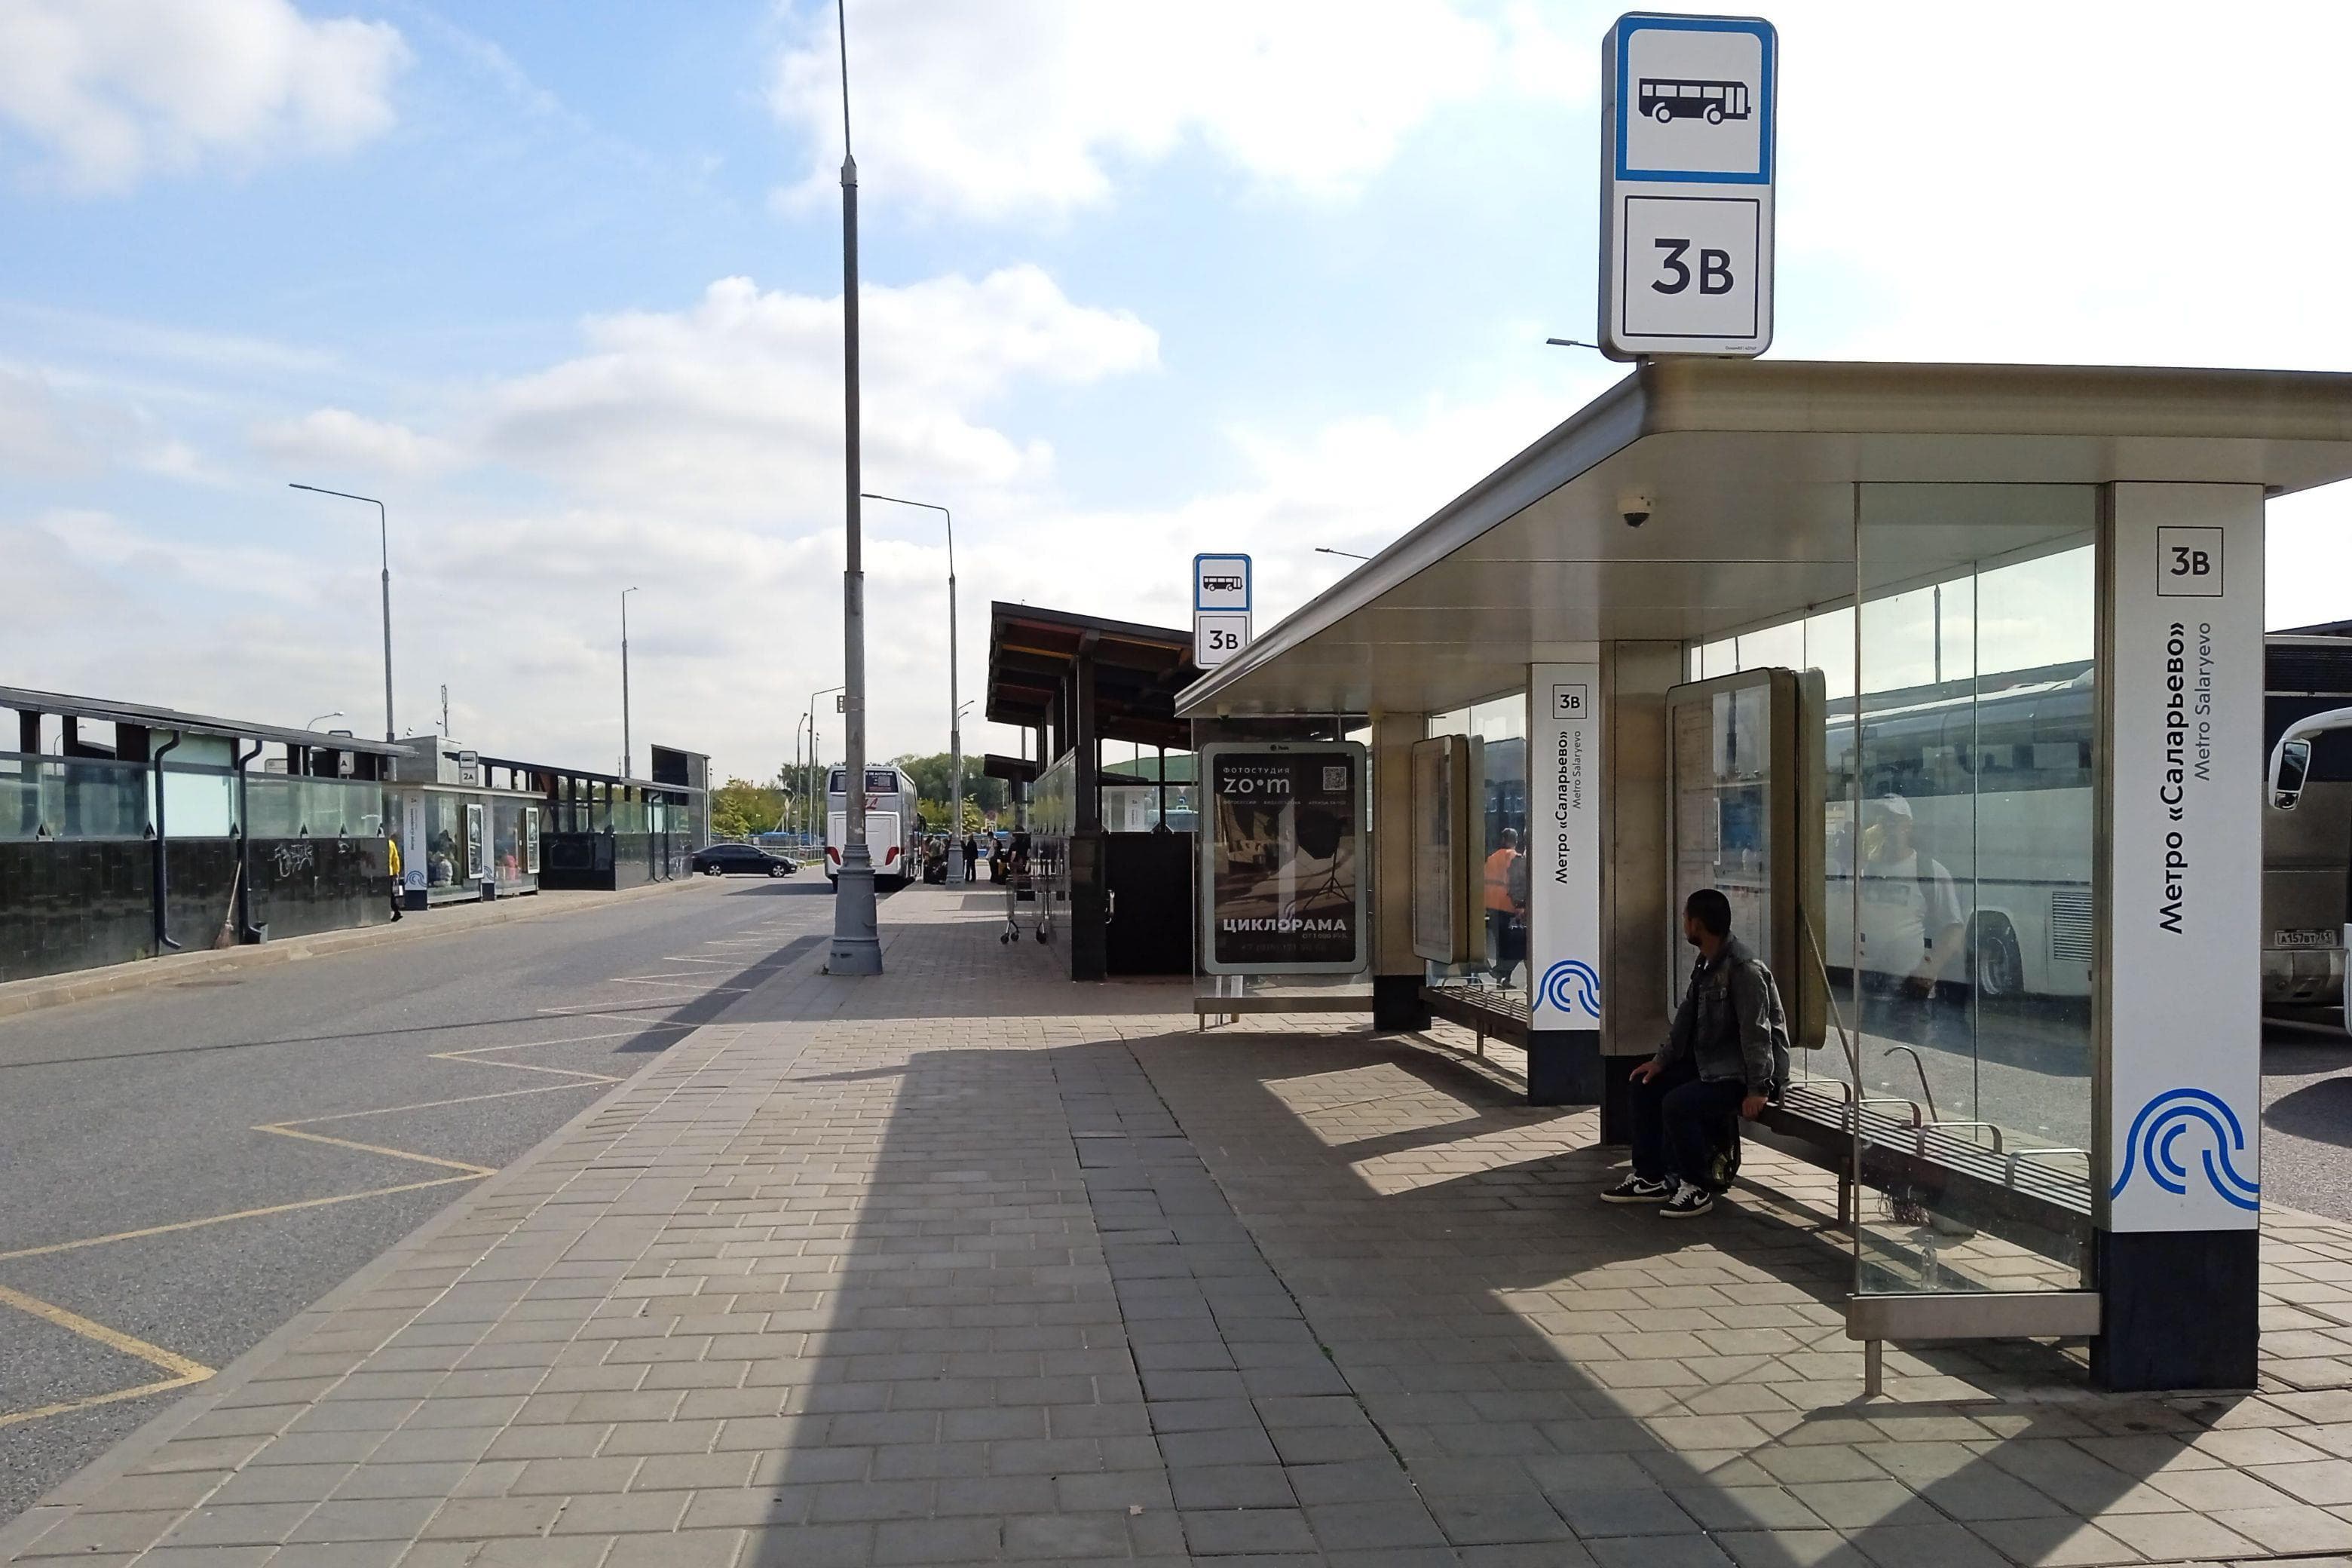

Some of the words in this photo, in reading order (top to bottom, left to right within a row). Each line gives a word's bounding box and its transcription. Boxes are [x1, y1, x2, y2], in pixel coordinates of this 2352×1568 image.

[1651, 237, 1734, 295] 3В
[2170, 547, 2210, 576] 3В
[1209, 629, 1239, 650] 3В
[2194, 623, 2215, 715] Salaryevo
[1560, 694, 1581, 709] 3В
[2160, 622, 2188, 822] «Саларьево»
[1573, 730, 1583, 777] Salaryevo
[2194, 721, 2210, 781] Metro
[1555, 730, 1570, 829] «Саларьево»
[1573, 779, 1582, 810] Metro
[1555, 833, 1570, 884] Метро
[2159, 831, 2188, 935] Метро
[1223, 918, 1347, 933] ЦИКЛОРАМА
